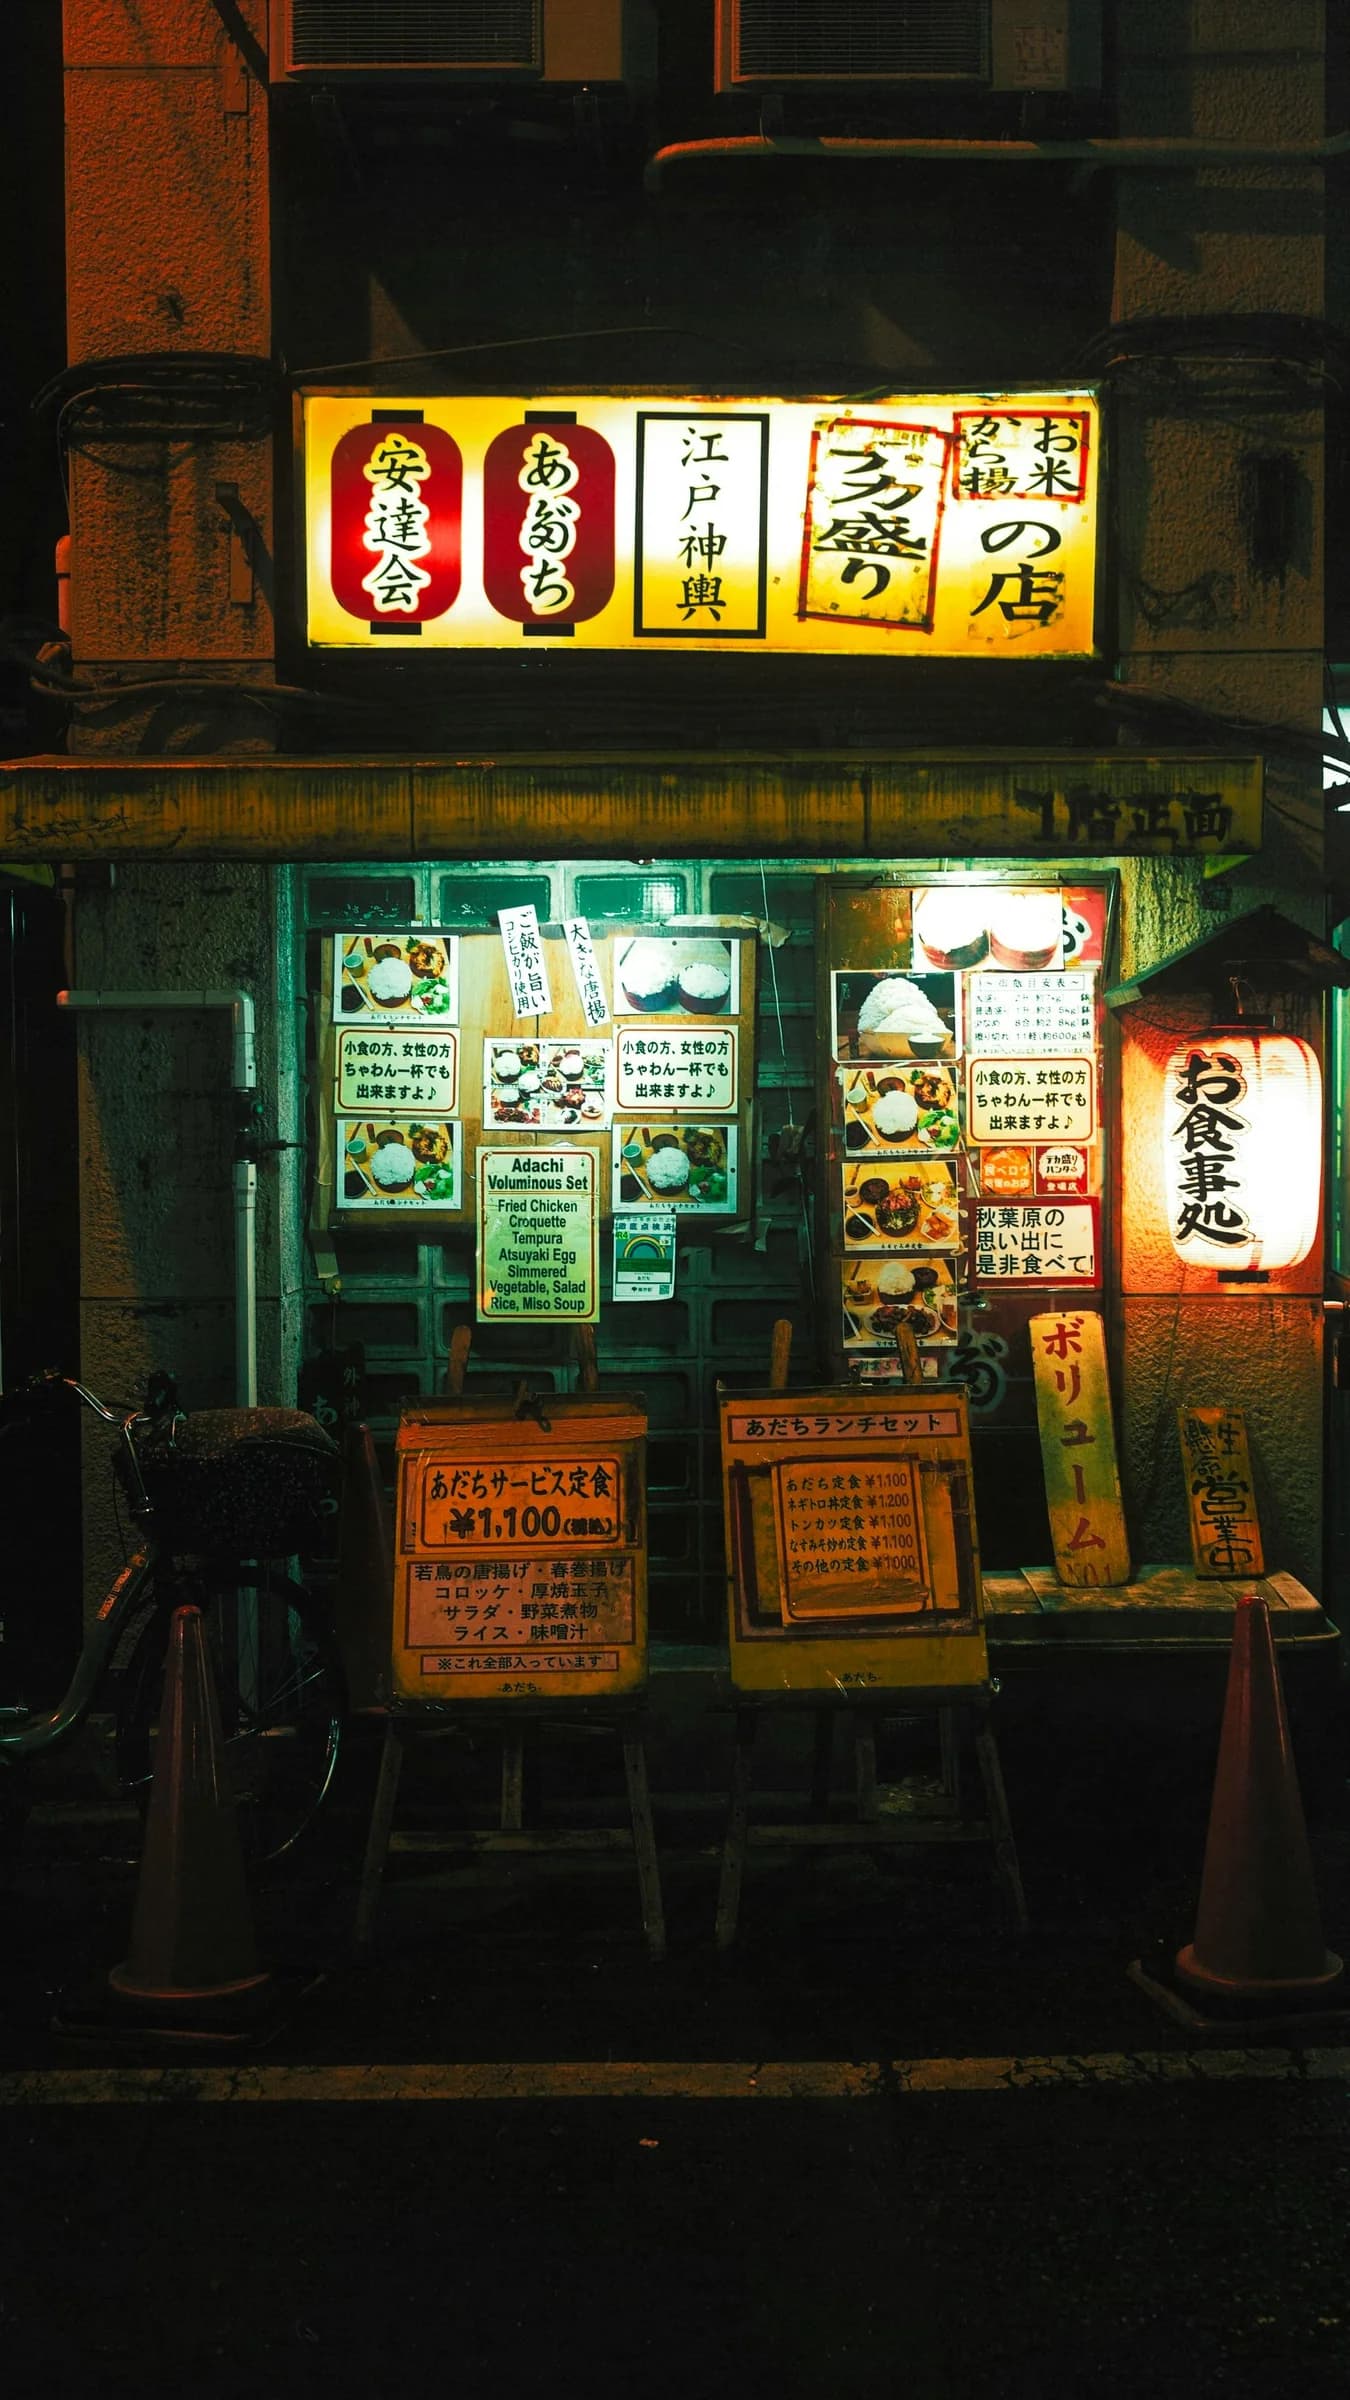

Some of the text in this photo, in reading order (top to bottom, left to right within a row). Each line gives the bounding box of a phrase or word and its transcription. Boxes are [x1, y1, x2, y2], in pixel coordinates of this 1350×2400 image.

[1026, 416, 1083, 496] お米
[371, 440, 424, 606] 安達会
[676, 426, 729, 622] 江戸神輿
[970, 521, 1065, 621] の店
[505, 921, 530, 1010] コシヒカリ使用
[520, 911, 546, 1008] ご飯が旨い
[570, 923, 606, 1023] 大きな唐揚
[344, 1040, 451, 1058] 小食の方、女性の方
[622, 1040, 729, 1056] 小食の方、女性の方
[344, 1062, 450, 1079] ちゃわん一杯でも
[623, 1061, 729, 1077] ちゃわん一杯でも
[975, 1070, 1087, 1085] 小食の方、女性の方
[976, 1092, 1087, 1108] ちゃわん一杯でも
[1172, 1054, 1249, 1244] お食事処
[511, 1158, 564, 1173] Adachi
[488, 1175, 589, 1190] Voluminous Set
[498, 1199, 578, 1213] Fried Chicken
[509, 1215, 567, 1231] Croquette
[976, 1207, 1065, 1228] 秋葉原の
[512, 1231, 563, 1247] Tempura
[976, 1231, 1063, 1252] 思い出に
[499, 1248, 576, 1264] Atsuyaki Egg
[508, 1264, 567, 1278] Simmered
[490, 1280, 586, 1295] Vegetable, Salad
[491, 1297, 585, 1312] Rice, Miso Soup
[746, 1414, 941, 1437] あだちランチセット
[1042, 1318, 1106, 1551] ボリューム
[430, 1464, 613, 1500] あだちサービス定食
[786, 1474, 861, 1491] あだち定食
[791, 1516, 865, 1532] トンカツ定食
[1192, 1470, 1254, 1573] 営業中
[792, 1557, 869, 1573] その他の定食
